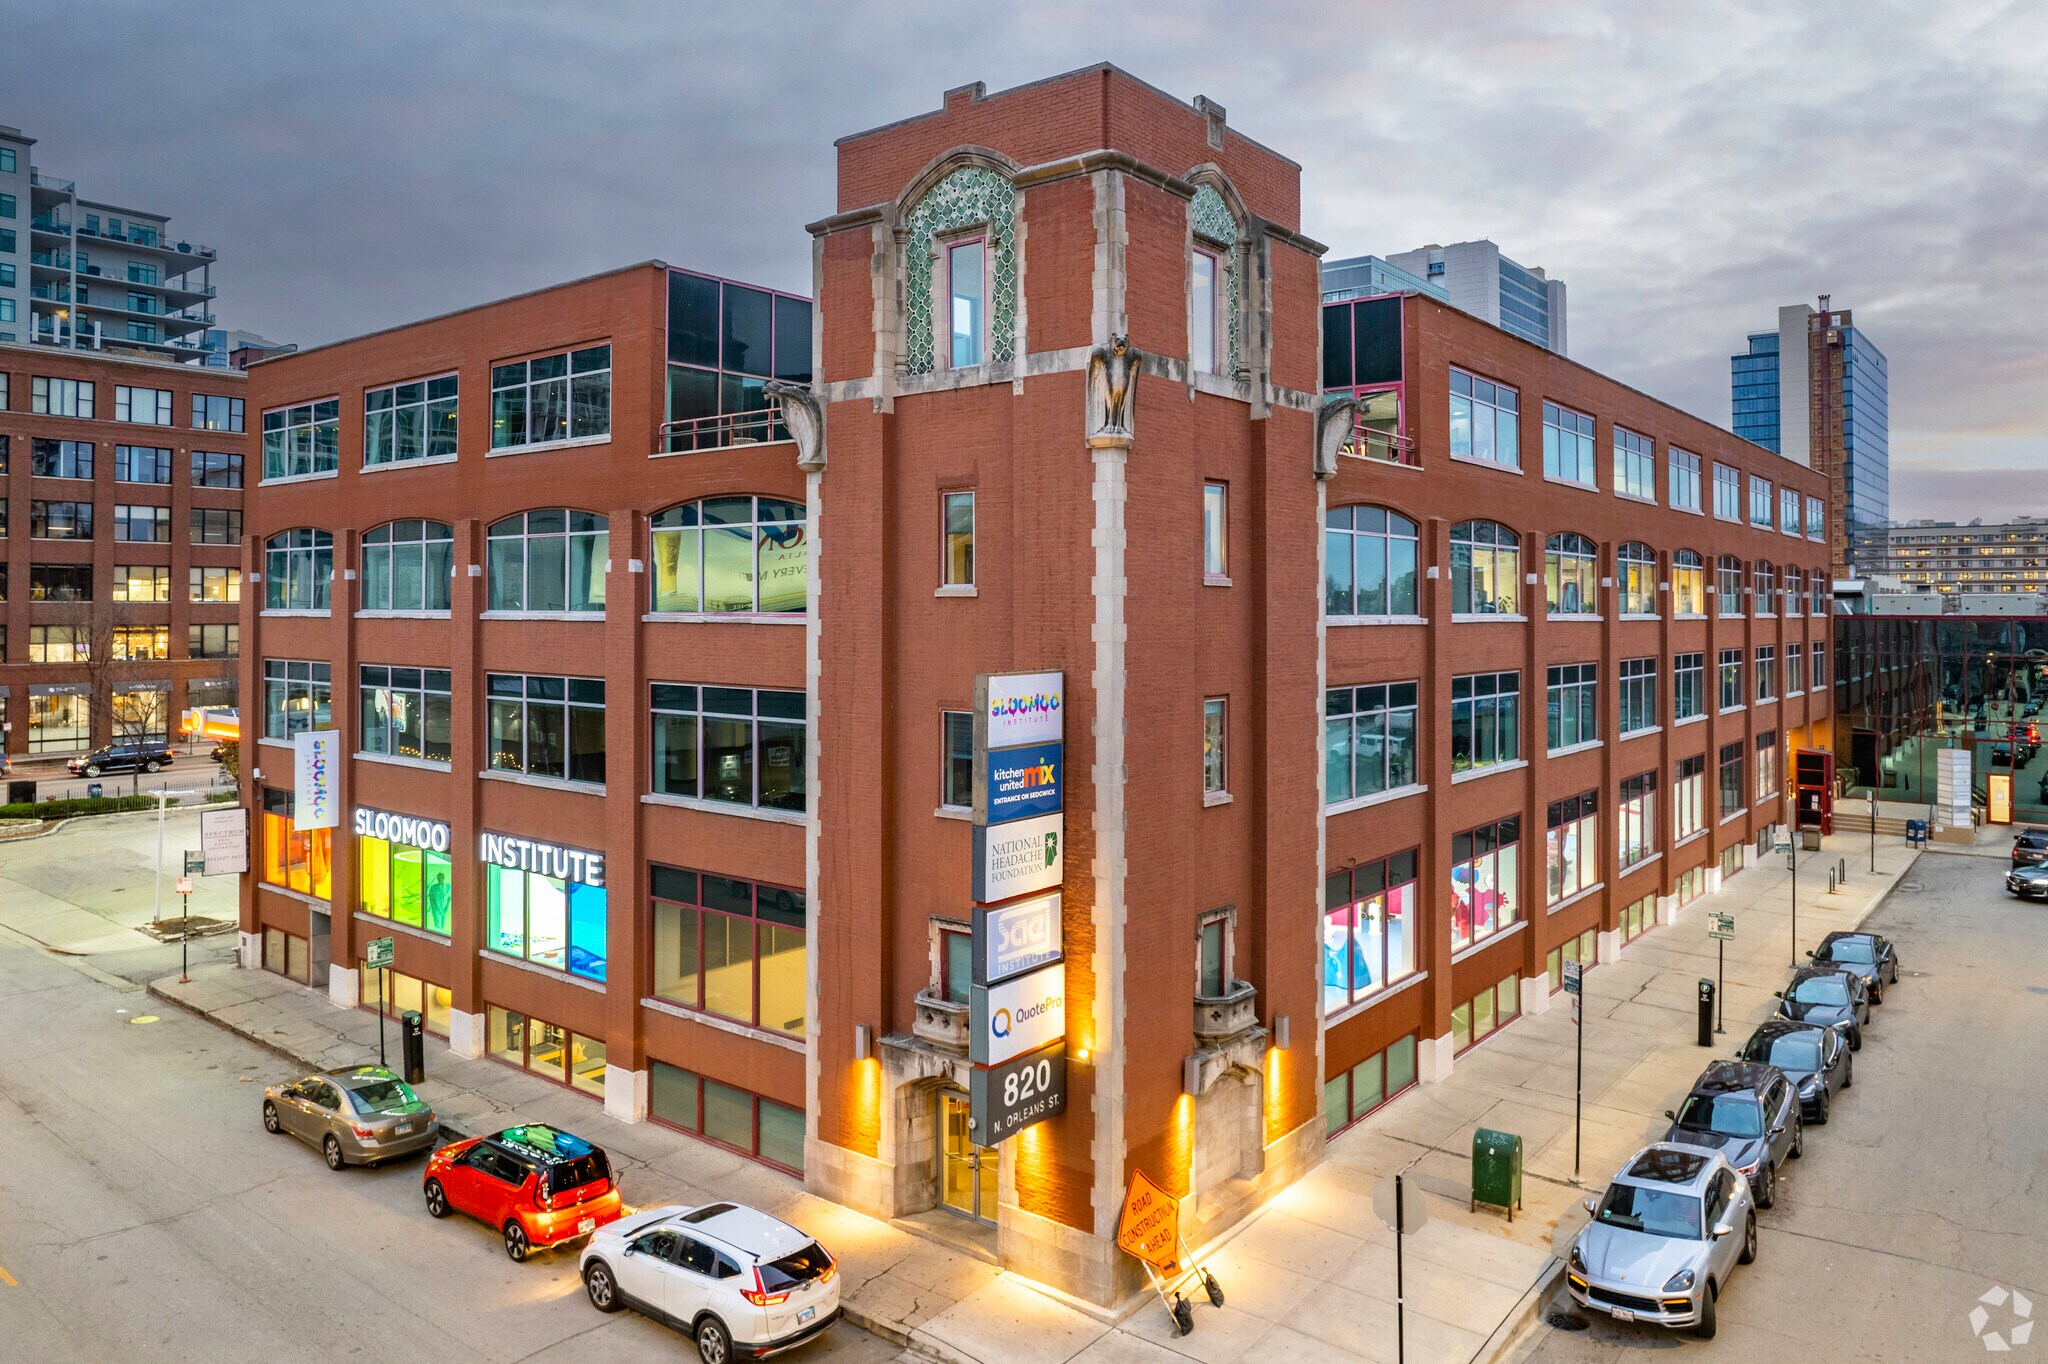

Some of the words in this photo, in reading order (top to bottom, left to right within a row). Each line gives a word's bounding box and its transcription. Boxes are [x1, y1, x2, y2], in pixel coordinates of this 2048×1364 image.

[992, 693, 1060, 717] SLOOMOO
[1003, 716, 1049, 726] INSTITUTE
[994, 767, 1024, 781] kitchen
[1024, 757, 1055, 788] mix
[994, 795, 1020, 805] ENTRANCE
[1021, 792, 1030, 800] ON
[1029, 788, 1056, 799] SEDGWICK
[1000, 778, 1024, 792] united
[355, 808, 449, 852] SLOOMOO
[992, 835, 1043, 857] NATIONAL
[481, 833, 603, 886] INSTITUTE
[992, 849, 1043, 870] HEADACHE
[991, 862, 1043, 883] FOUNDATION
[998, 950, 1051, 974] INSTITUTE
[1016, 997, 1062, 1023] QuotePro
[1004, 1059, 1051, 1107] 820
[994, 1120, 1003, 1134] N.
[1006, 1100, 1045, 1128] ORLEANS
[1048, 1093, 1060, 1109] ST.
[1131, 1192, 1152, 1215] ROAD
[1122, 1200, 1175, 1247] CONSTRUCTION
[1146, 1228, 1172, 1255] AHEAD
